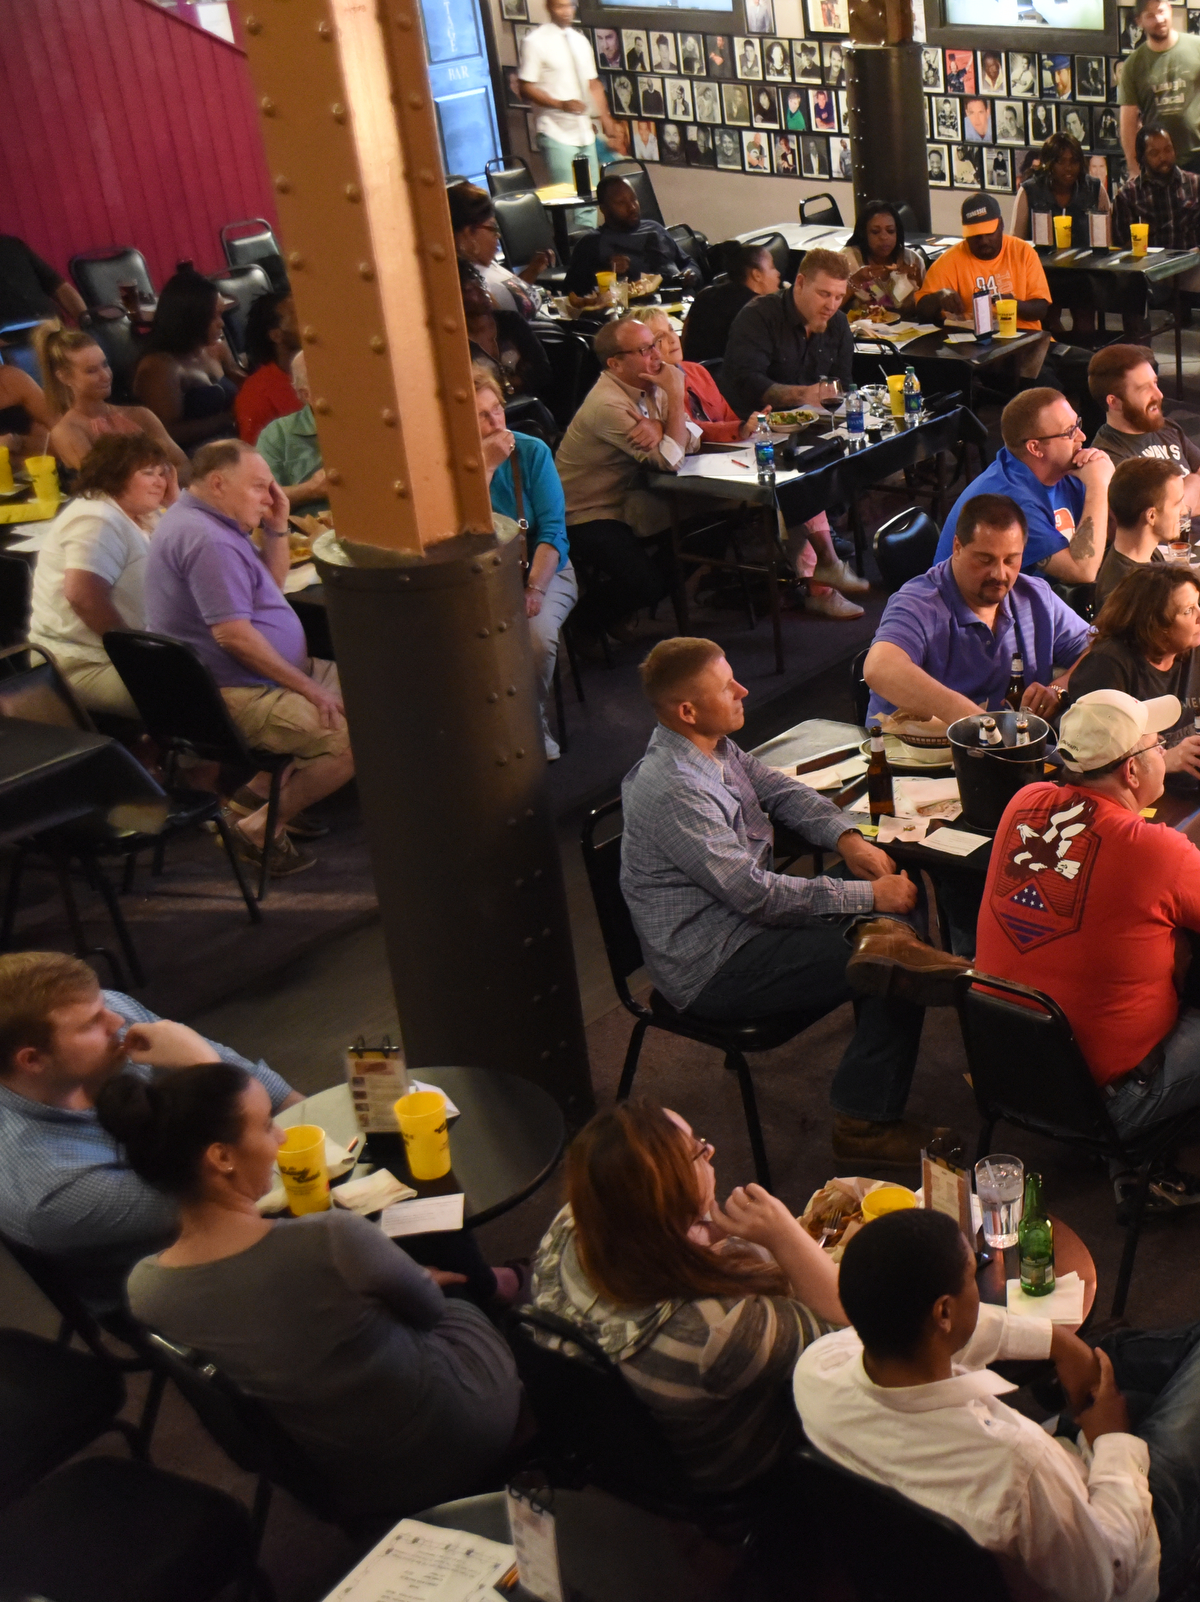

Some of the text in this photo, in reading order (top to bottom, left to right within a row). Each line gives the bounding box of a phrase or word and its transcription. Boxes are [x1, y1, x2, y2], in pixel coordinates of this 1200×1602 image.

[442, 1, 458, 52] TAGE
[447, 65, 470, 81] BAR
[1153, 78, 1187, 93] Laugh
[975, 274, 998, 296] 94
[1140, 444, 1181, 460] WAYS
